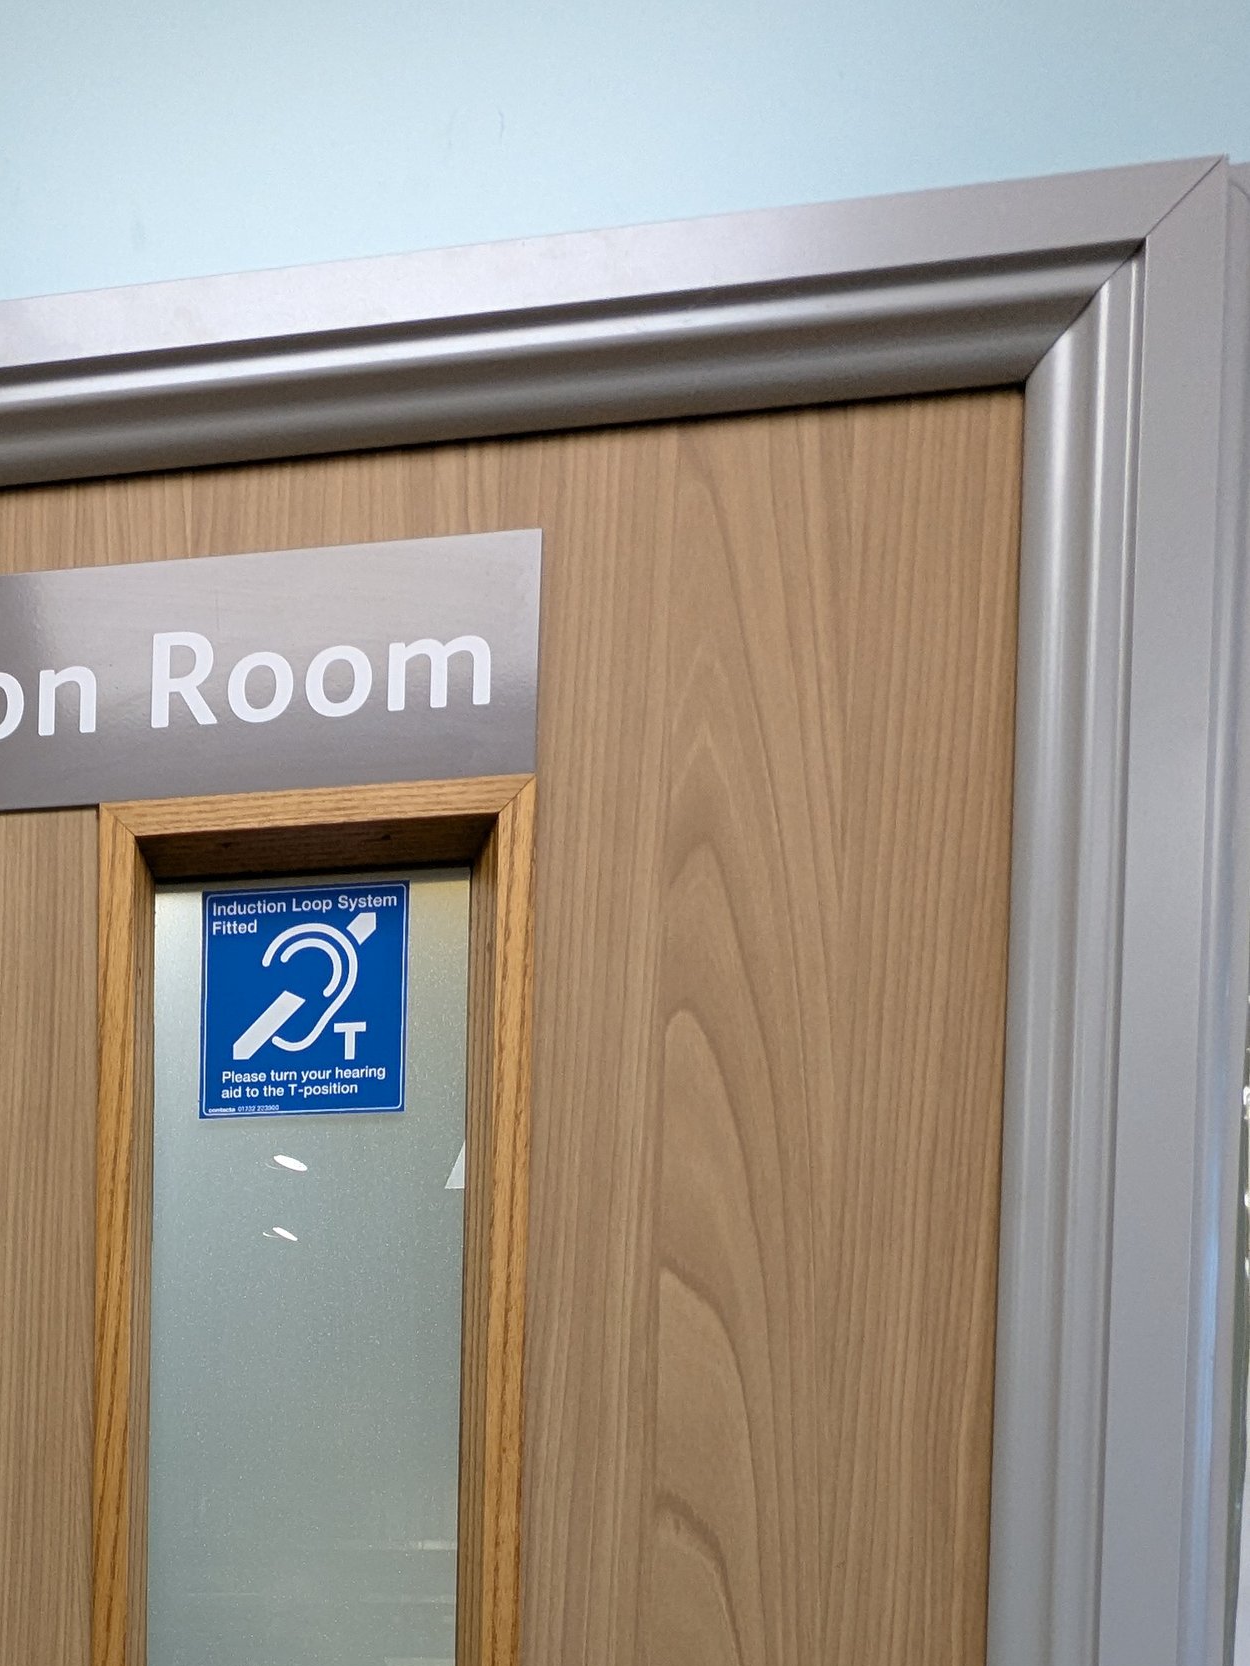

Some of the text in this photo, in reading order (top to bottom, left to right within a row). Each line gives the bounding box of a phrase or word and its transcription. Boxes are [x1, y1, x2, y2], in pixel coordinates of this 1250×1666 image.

[151, 632, 492, 726] Room
[212, 894, 397, 916] Induction Loop System
[212, 918, 257, 935] Fitted
[334, 1021, 366, 1060] T
[222, 1065, 385, 1083] Please turn your hearing
[221, 1083, 358, 1098] aid to the T-position
